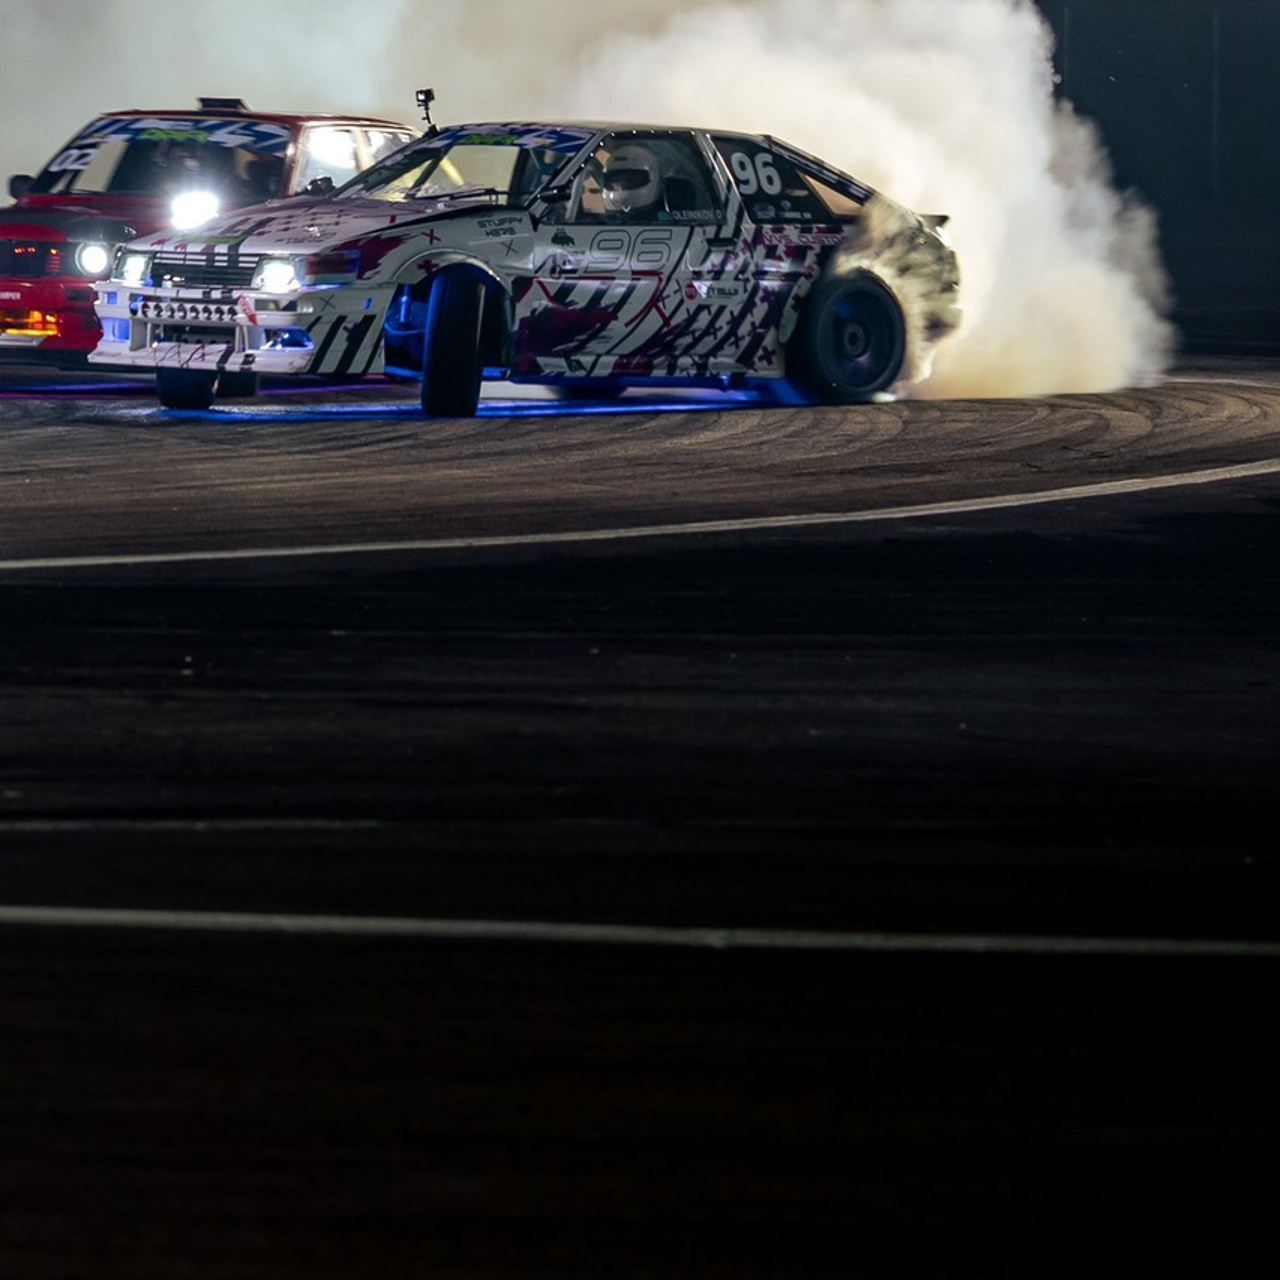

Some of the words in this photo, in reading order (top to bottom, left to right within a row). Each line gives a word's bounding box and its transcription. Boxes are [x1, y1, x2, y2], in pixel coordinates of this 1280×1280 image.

[48, 148, 97, 172] 02
[730, 151, 783, 196] 96
[583, 228, 673, 274] 96
[798, 233, 847, 245] CUSTO
